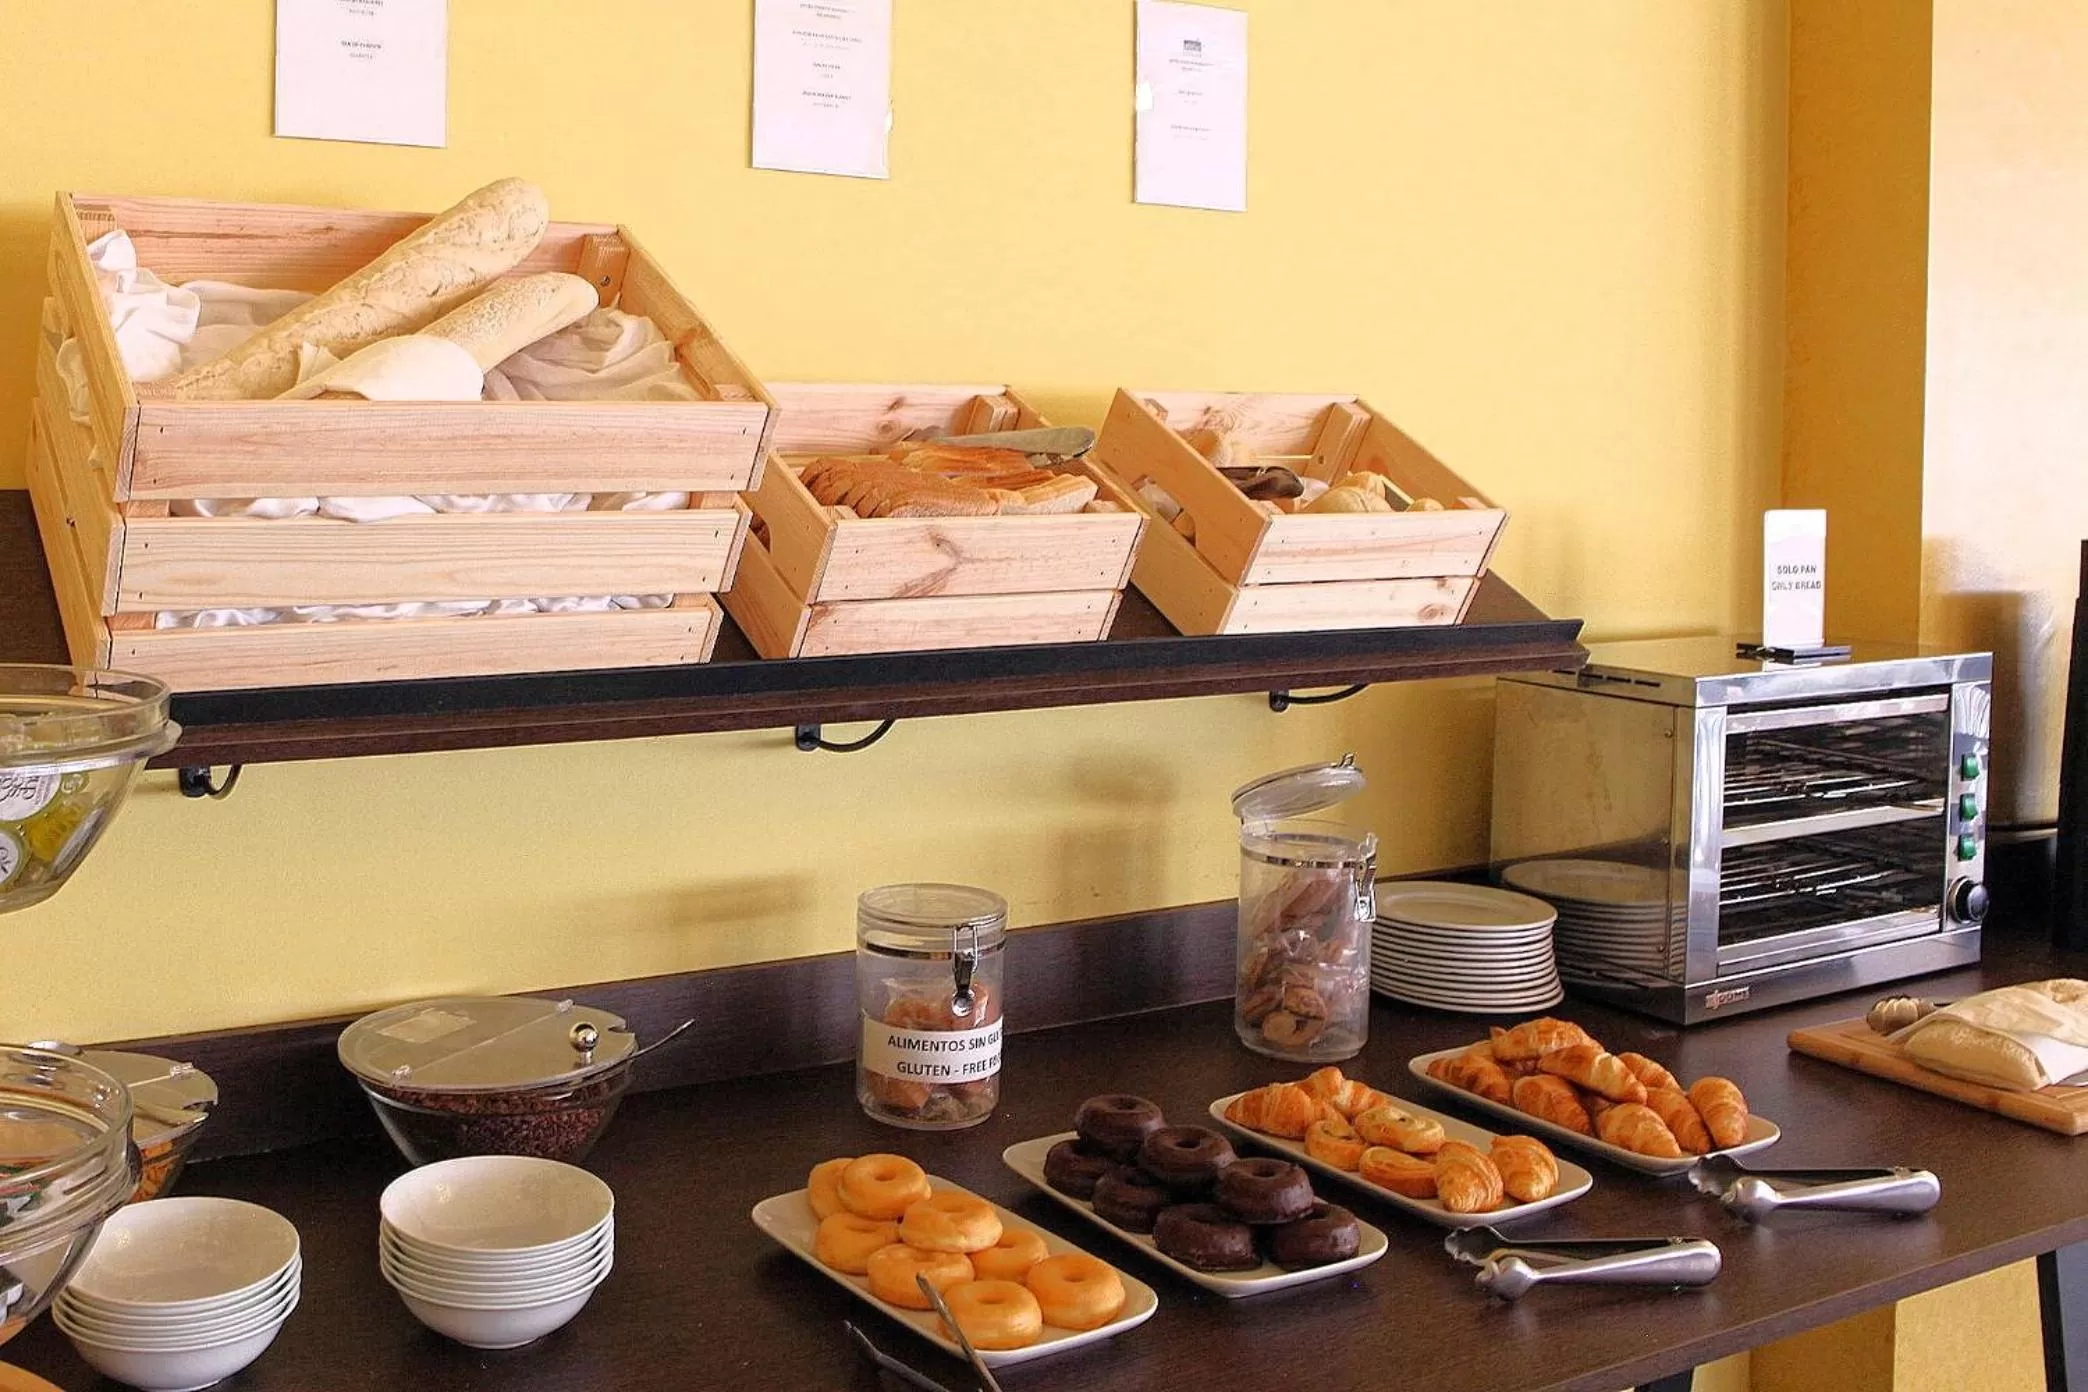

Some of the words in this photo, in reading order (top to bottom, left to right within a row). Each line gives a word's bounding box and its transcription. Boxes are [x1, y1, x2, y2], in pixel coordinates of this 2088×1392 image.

[1777, 564, 1799, 574] SOLO
[1800, 564, 1817, 574] PAN
[888, 1035, 965, 1051] ALIMENTOS
[969, 1036, 986, 1050] SIN
[897, 1061, 950, 1076] GLUTEN
[962, 1059, 987, 1075] FREE
